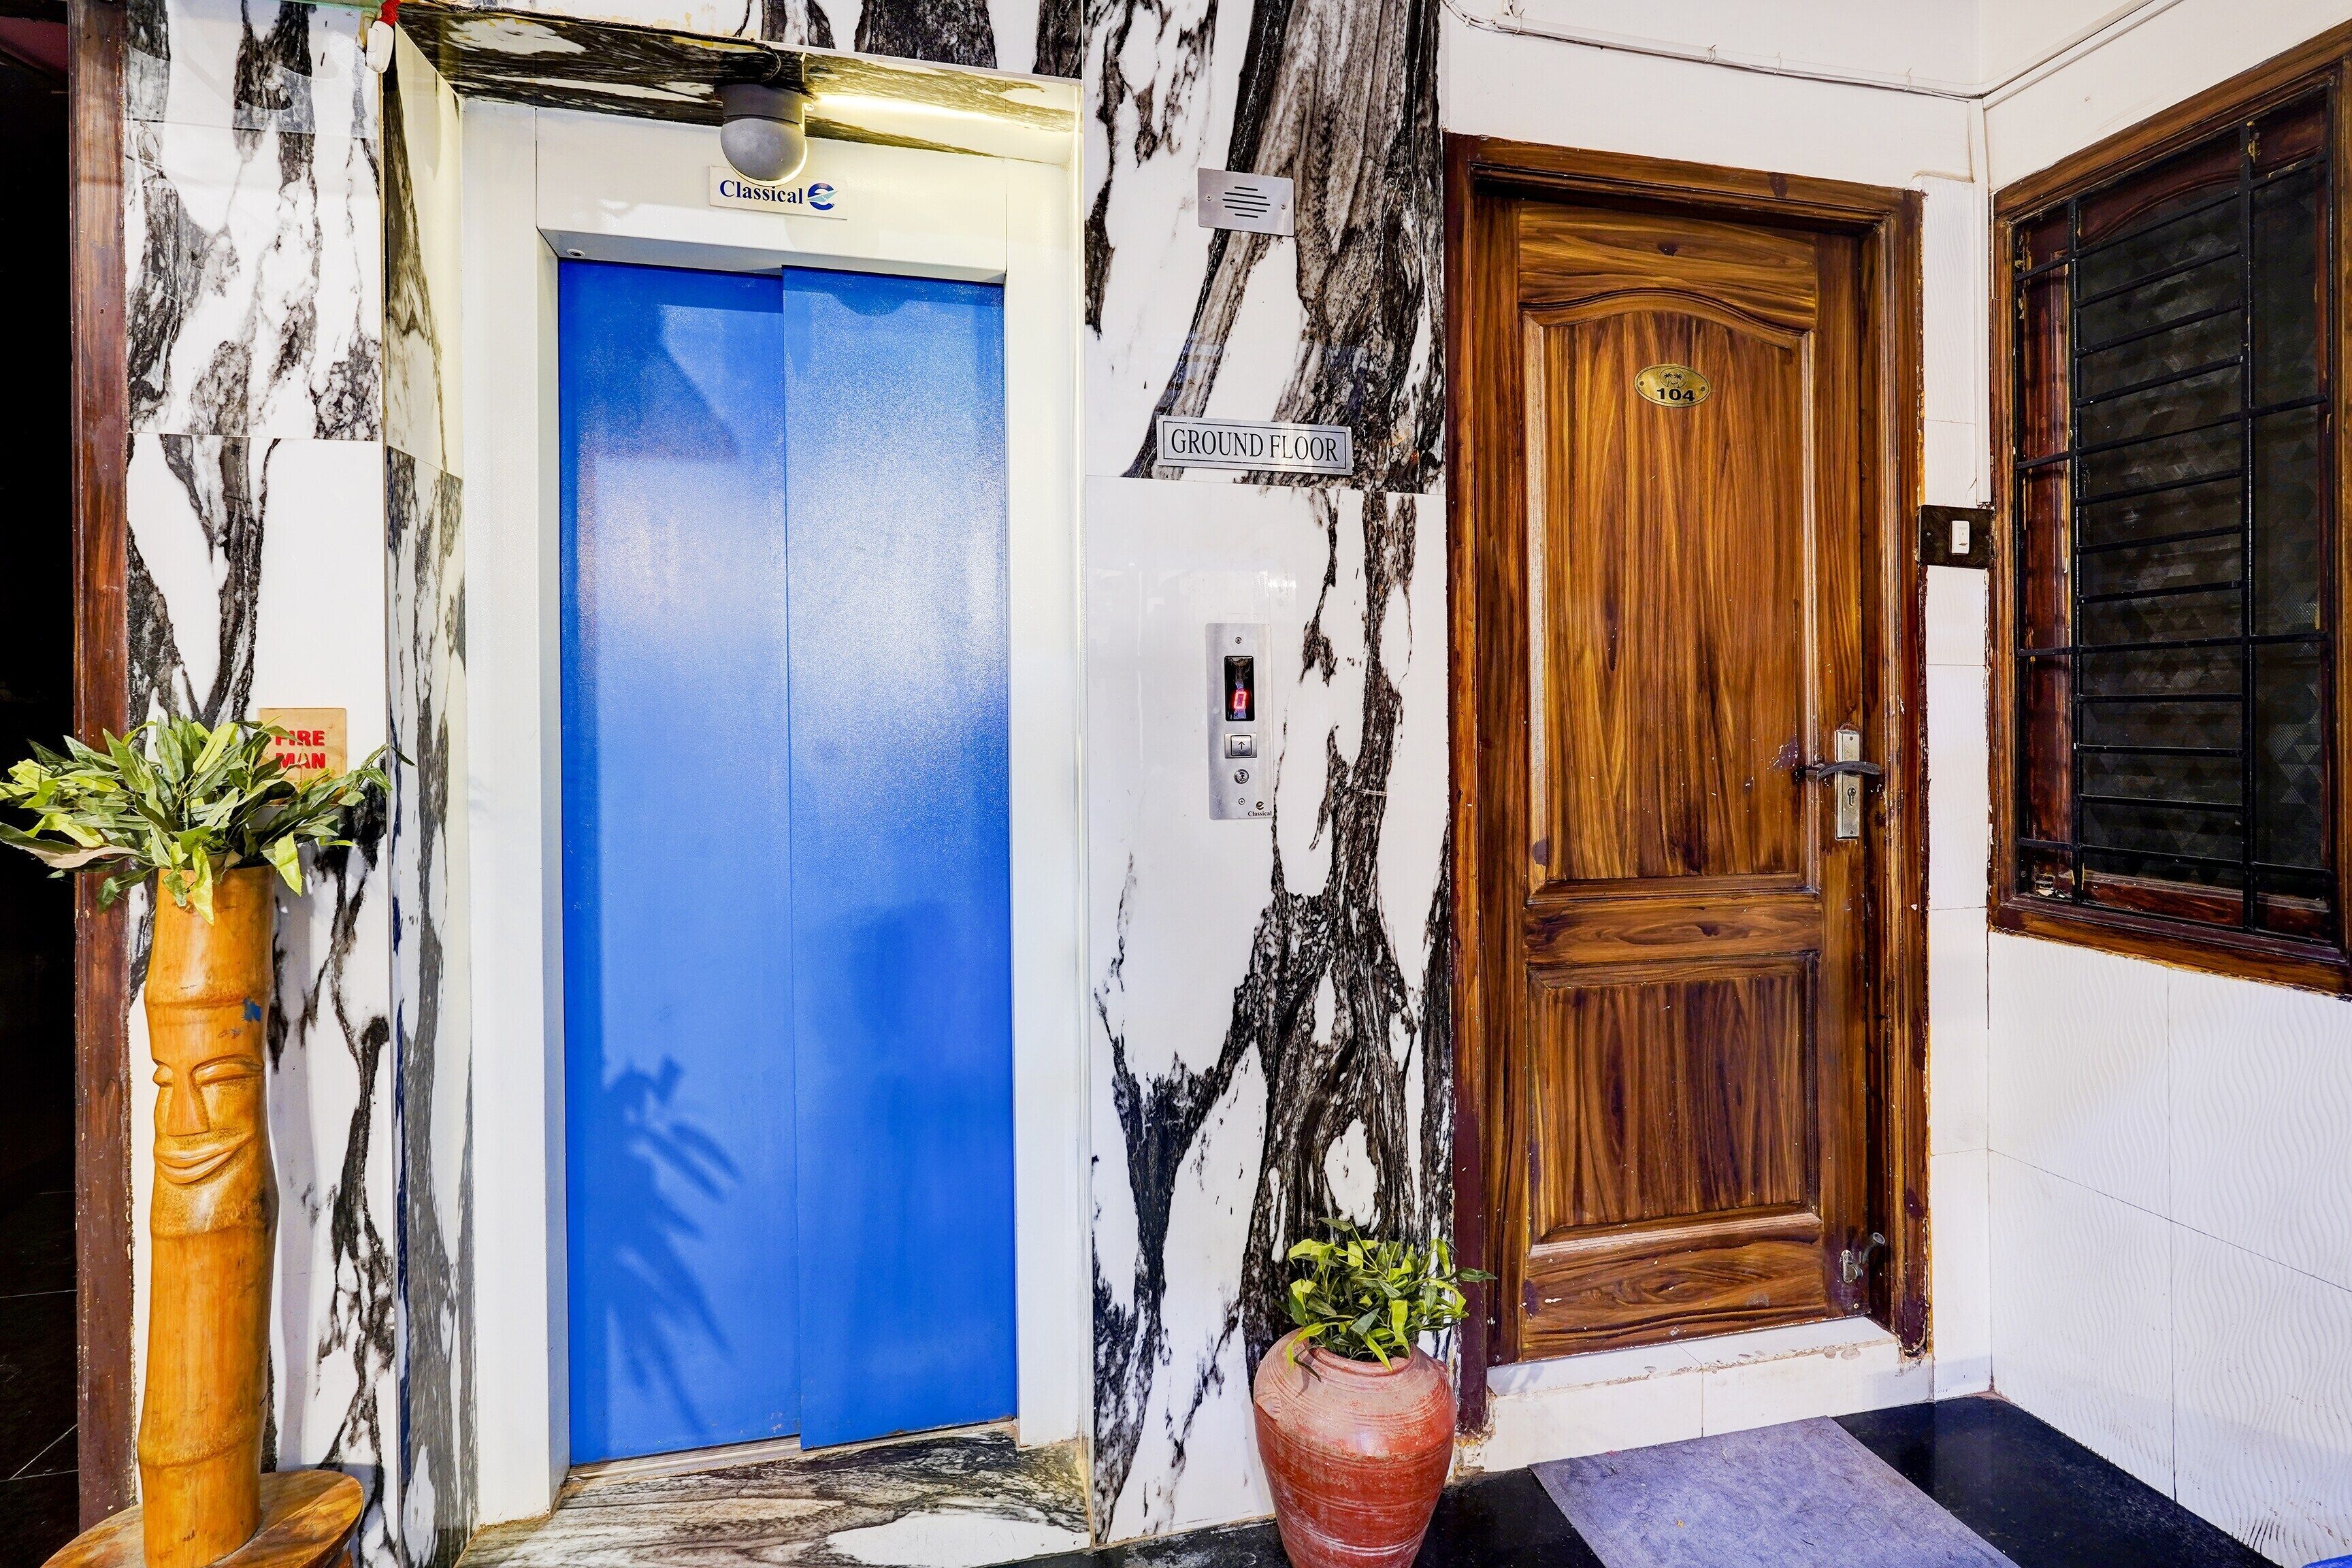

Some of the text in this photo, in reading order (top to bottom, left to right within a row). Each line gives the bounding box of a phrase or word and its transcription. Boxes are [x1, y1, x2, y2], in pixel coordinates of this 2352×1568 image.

[719, 180, 804, 204] Classical
[1656, 387, 1695, 402] 104
[1171, 429, 1339, 462] GROUND FLOOR
